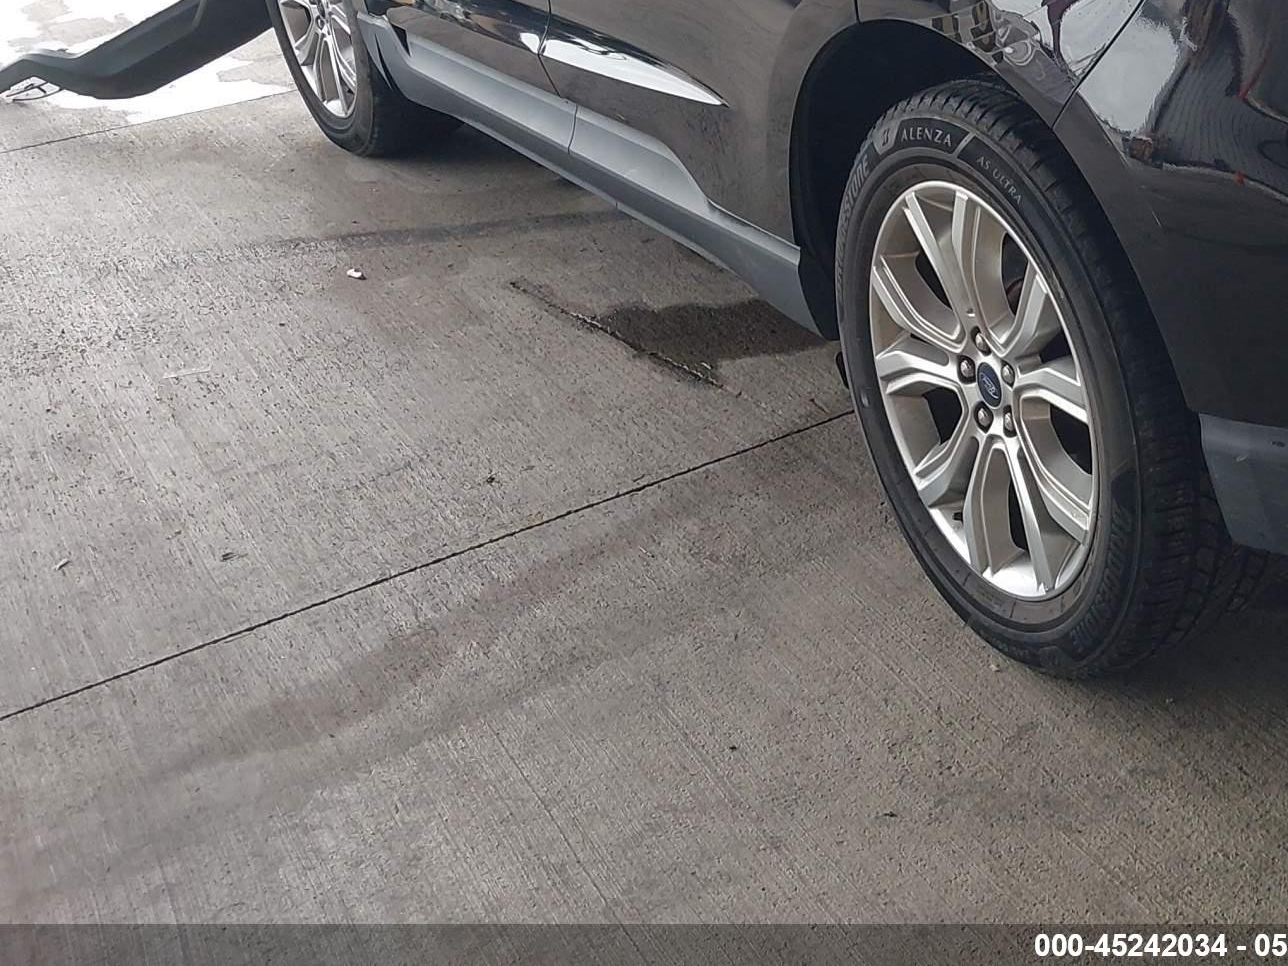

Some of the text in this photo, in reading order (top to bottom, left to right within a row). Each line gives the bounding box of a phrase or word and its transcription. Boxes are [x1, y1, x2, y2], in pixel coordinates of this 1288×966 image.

[901, 126, 952, 147] ALENZA
[976, 155, 1022, 205] AS ULTRA
